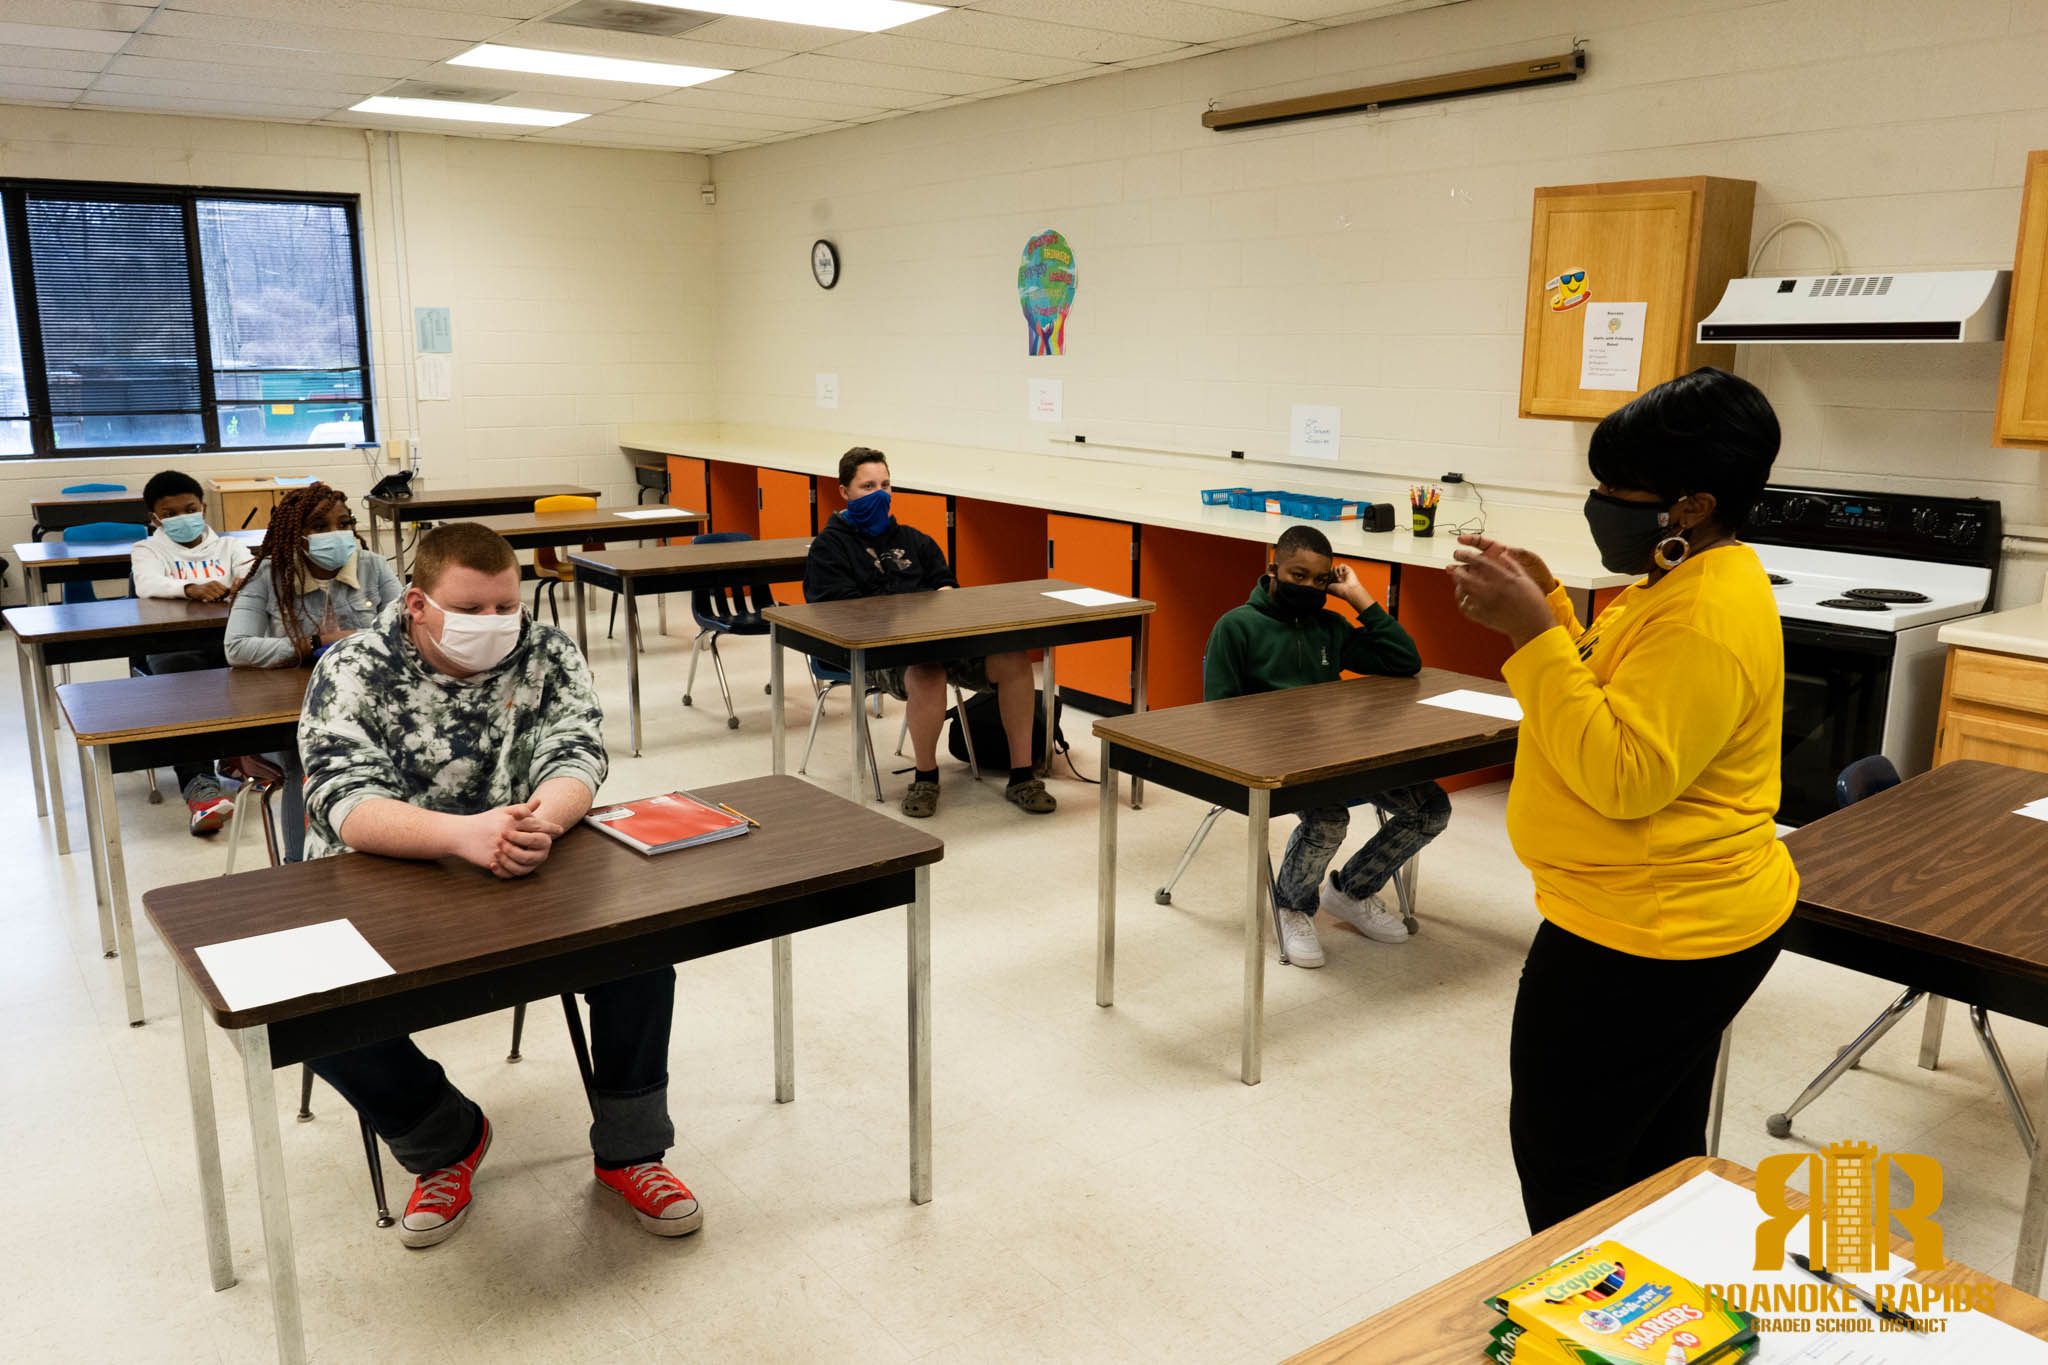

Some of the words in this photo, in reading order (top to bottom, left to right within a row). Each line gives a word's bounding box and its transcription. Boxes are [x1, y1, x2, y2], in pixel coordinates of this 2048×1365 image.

[1545, 1261, 1616, 1300] Crayola
[1623, 1304, 1705, 1350] MARKERS
[1675, 1332, 1697, 1348] 10
